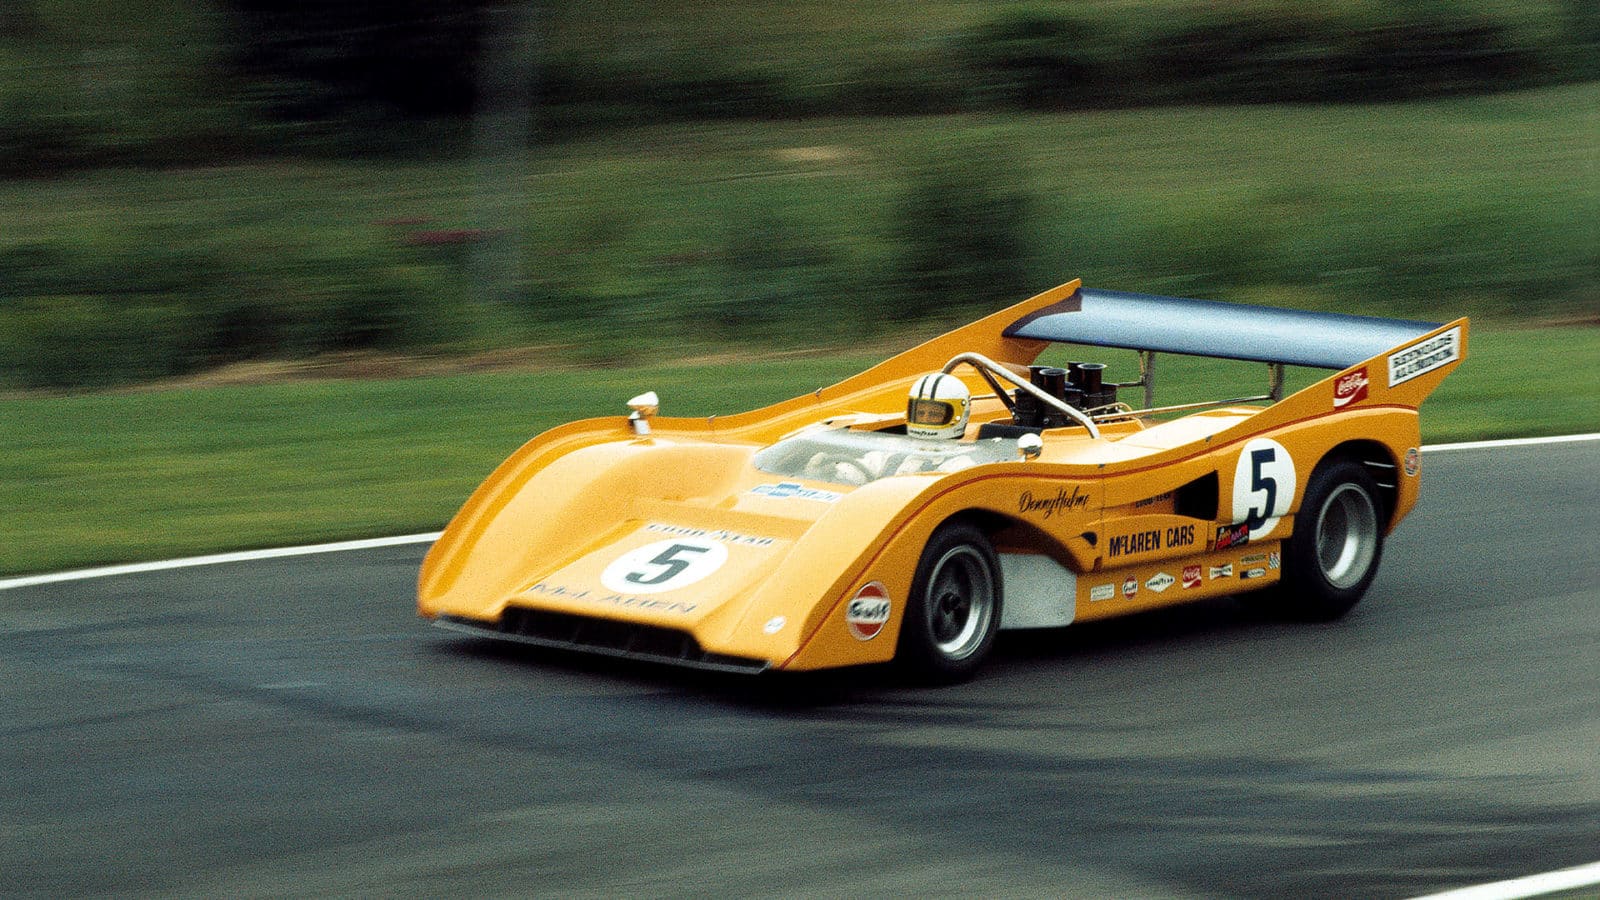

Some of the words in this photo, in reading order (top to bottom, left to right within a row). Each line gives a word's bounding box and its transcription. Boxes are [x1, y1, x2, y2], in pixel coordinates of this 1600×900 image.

[1247, 448, 1277, 531] 5
[1167, 524, 1195, 548] CARS
[625, 544, 711, 584] 5
